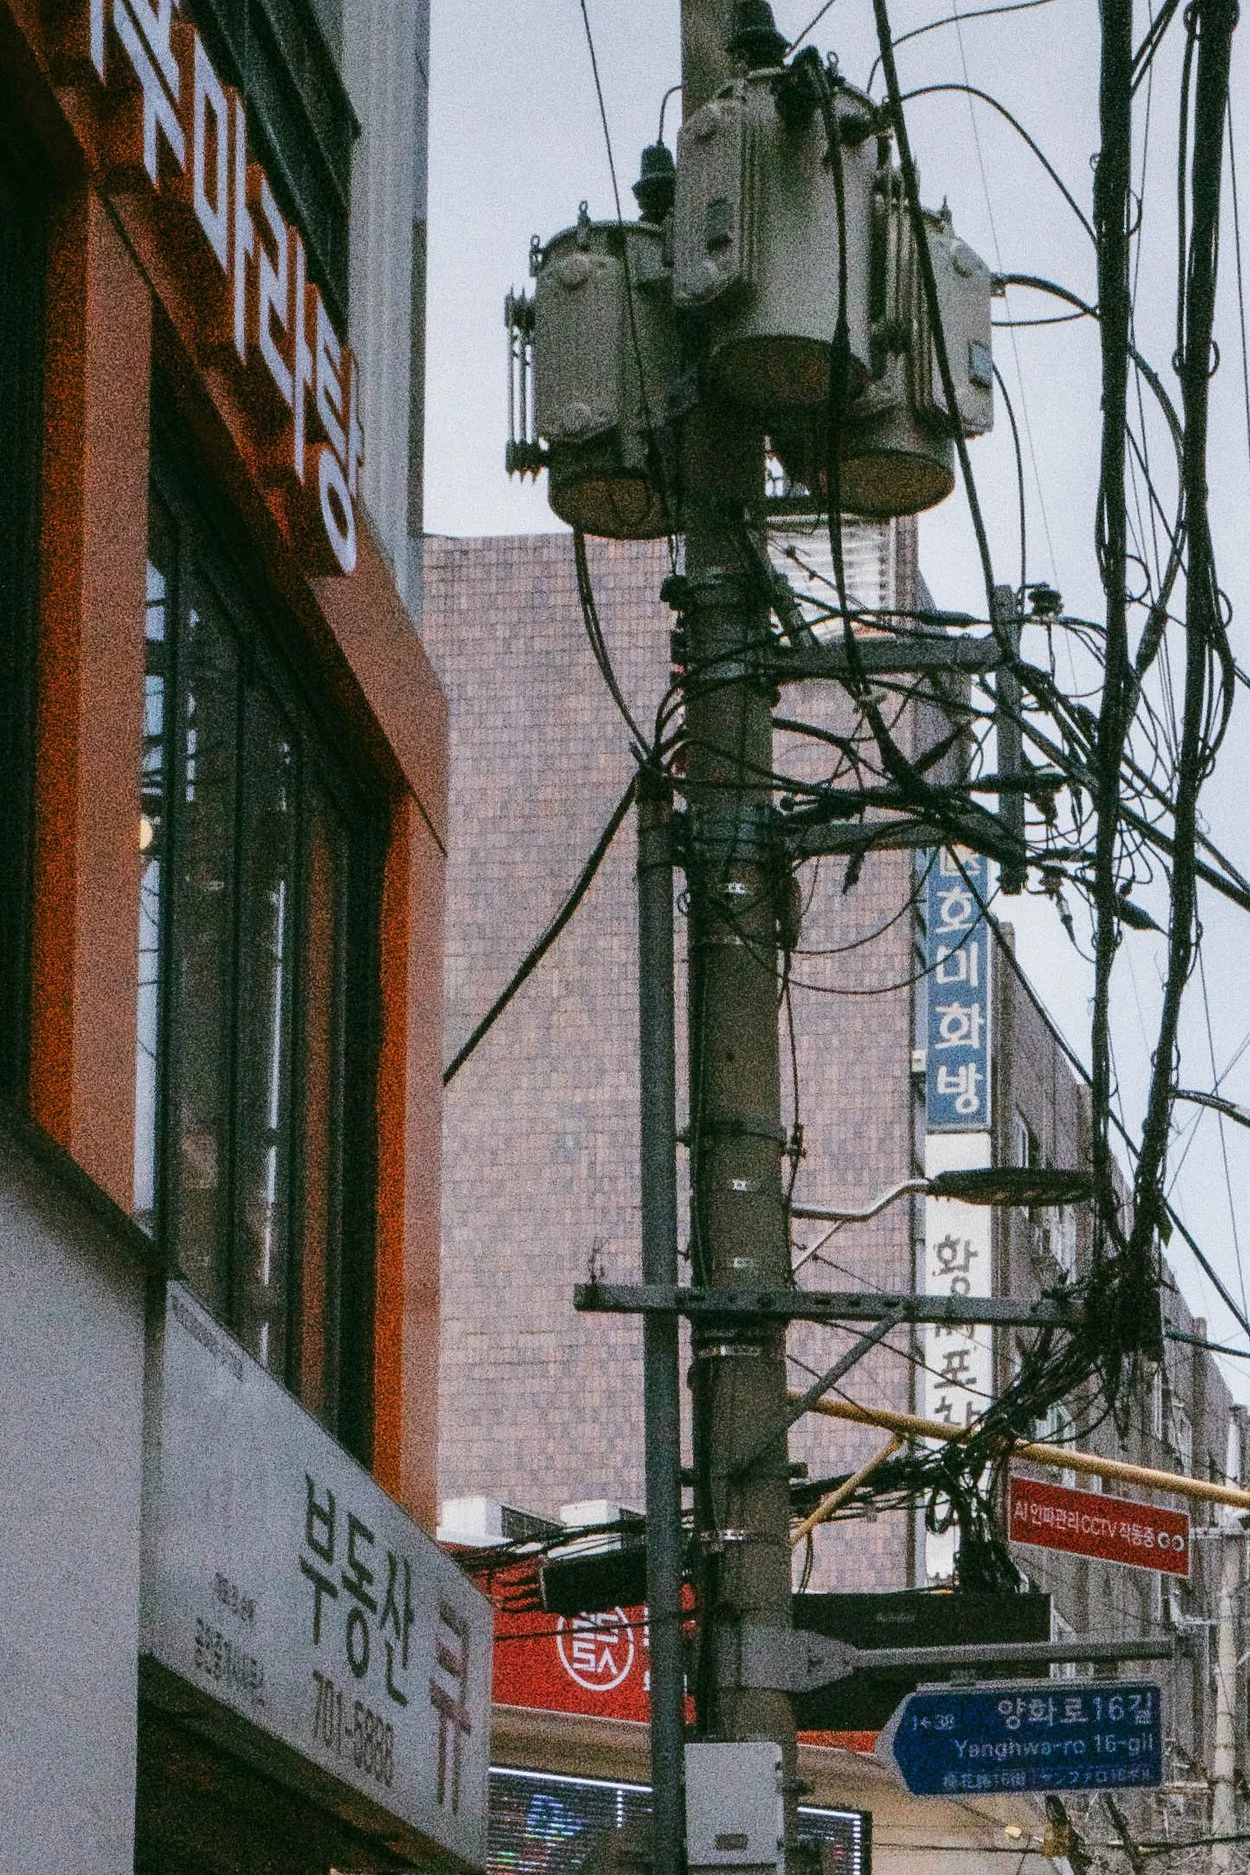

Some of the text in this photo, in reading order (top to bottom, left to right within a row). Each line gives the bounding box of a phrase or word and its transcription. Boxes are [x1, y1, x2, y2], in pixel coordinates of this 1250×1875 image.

[934, 890, 985, 1114] 호미화방
[934, 1234, 980, 1428] 황포차
[299, 1473, 472, 1814] 부동산 큐
[953, 1738, 1087, 1761] Yanghwa-ro
